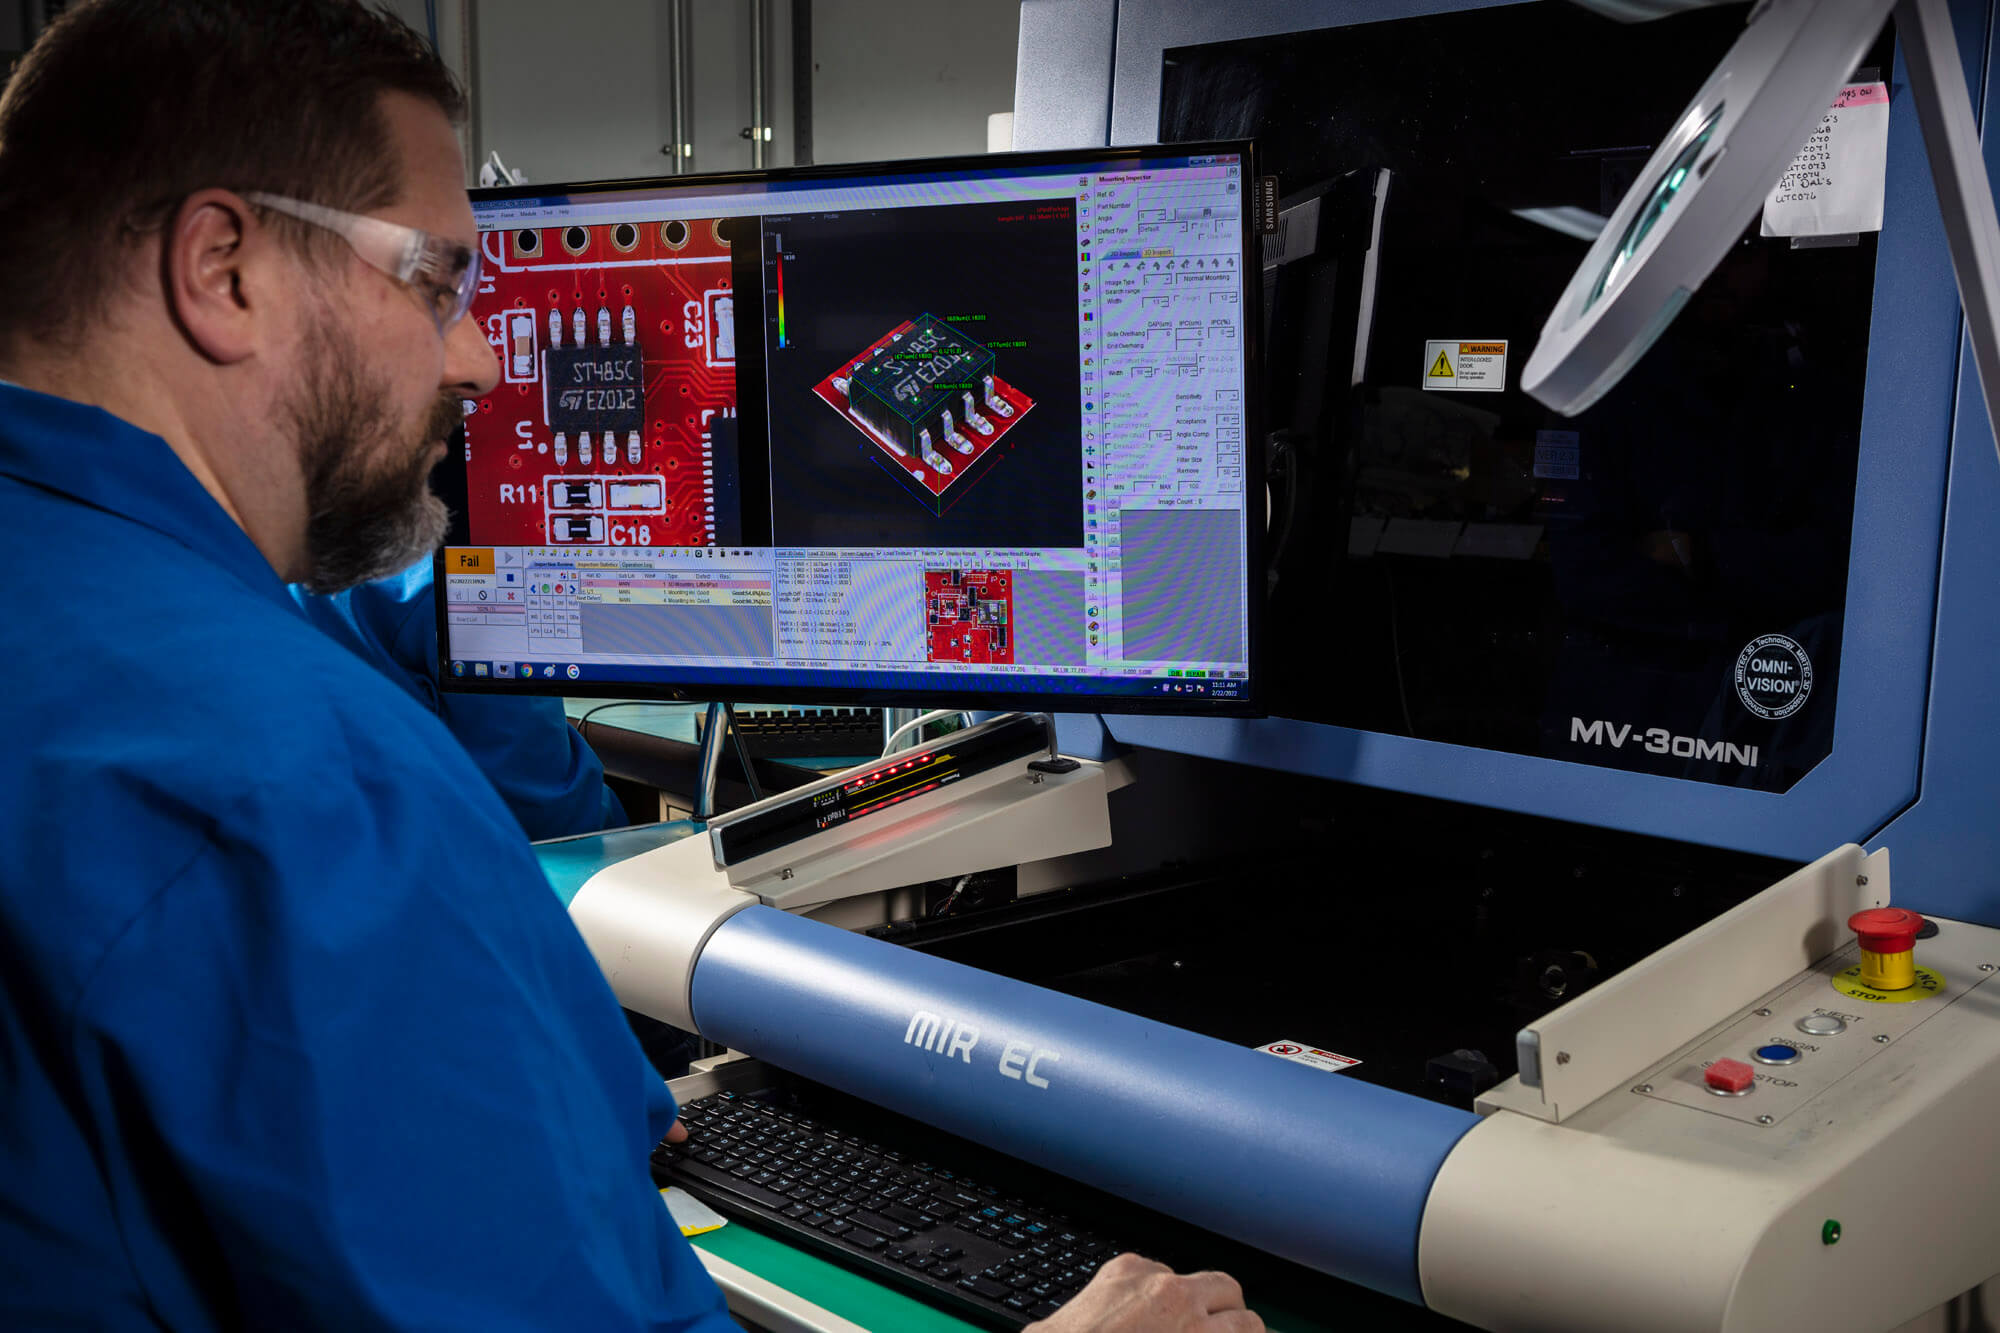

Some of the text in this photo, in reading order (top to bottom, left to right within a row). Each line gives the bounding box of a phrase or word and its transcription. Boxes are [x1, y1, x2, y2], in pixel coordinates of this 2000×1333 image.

[1265, 181, 1274, 230] SAMSUNG
[487, 313, 503, 346] C3
[683, 300, 703, 349] C23
[573, 360, 635, 383] ST485C
[587, 388, 636, 410] EZ012
[515, 421, 533, 450] U1
[499, 484, 536, 504] R11
[610, 525, 651, 546] C18
[460, 555, 479, 567] Fail
[1736, 654, 1748, 683] MIRTEC
[1757, 637, 1795, 650] Technology
[1751, 658, 1793, 675] OMNI-
[1796, 649, 1811, 678] MIRTEC
[1747, 677, 1795, 694] VISION
[1739, 687, 1769, 717] Technology
[1774, 693, 1806, 716] Inspection
[1847, 989, 1887, 1000] STOP
[1812, 1007, 1865, 1023] EJECT
[1769, 1036, 1821, 1052] ORIGIN
